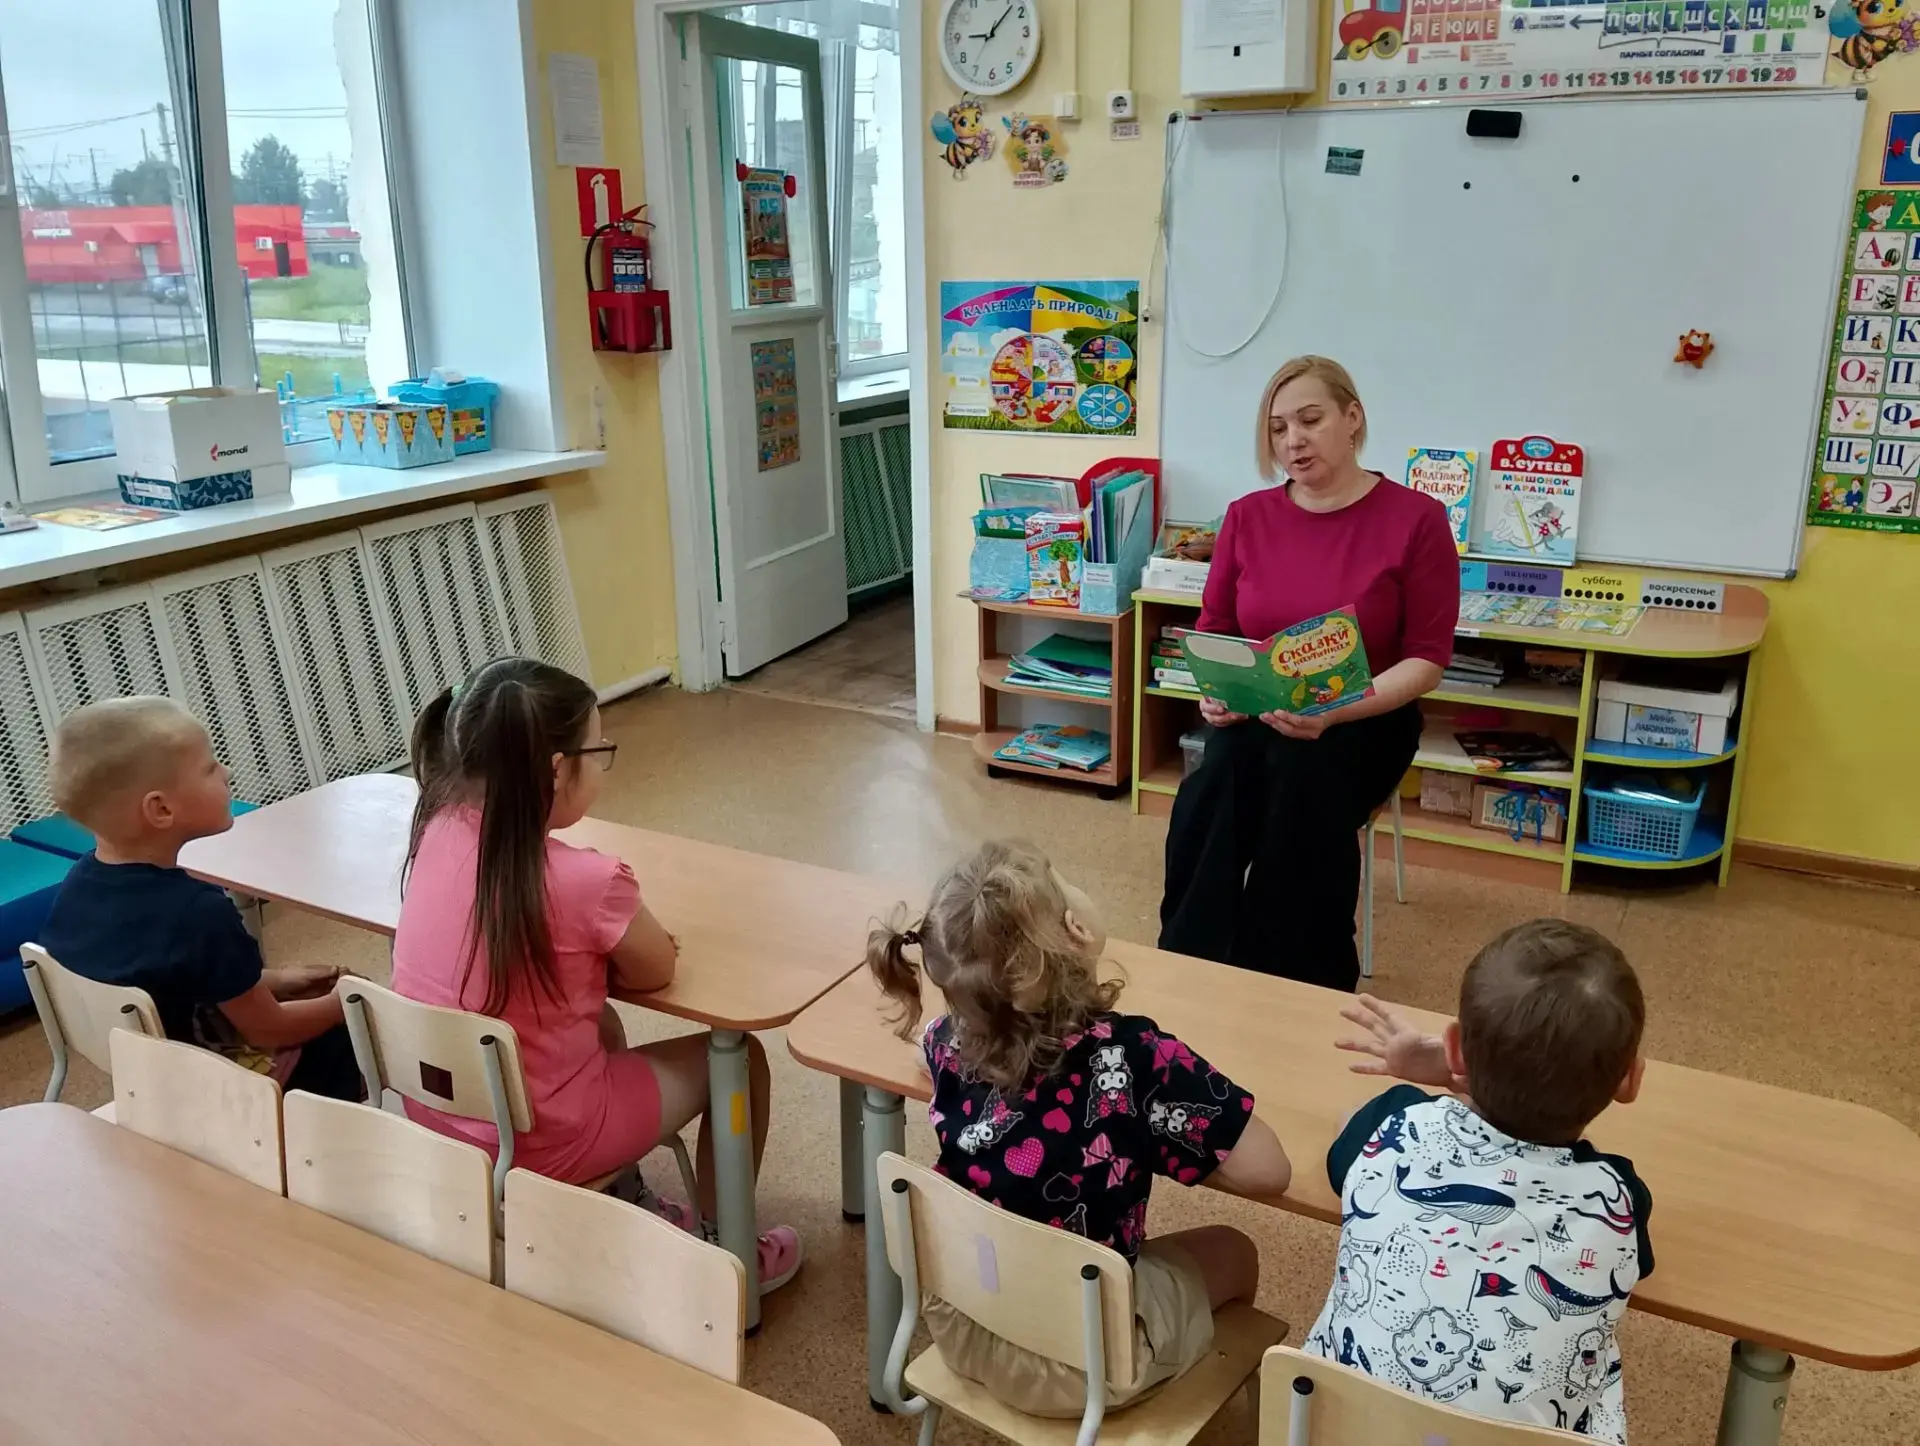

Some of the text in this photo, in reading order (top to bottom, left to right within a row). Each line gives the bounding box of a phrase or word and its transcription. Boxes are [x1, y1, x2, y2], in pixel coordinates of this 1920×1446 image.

[1017, 6, 1025, 19] 2
[1626, 11, 1642, 26] Ф
[1647, 10, 1660, 26] К
[1668, 10, 1679, 25] Т
[1684, 9, 1703, 24] Ш
[1707, 8, 1720, 24] С
[1727, 7, 1742, 23] Х
[1749, 7, 1763, 26] Ц
[1814, 5, 1826, 19] Ъ
[1022, 25, 1030, 38] 3
[1411, 22, 1423, 37] Я
[1447, 20, 1462, 34] Ю
[1465, 20, 1480, 34] И
[1486, 19, 1496, 34] Е
[953, 32, 961, 45] 9
[960, 52, 967, 63] 8
[1655, 49, 1706, 57] СОГЛАСНЫЕ
[972, 65, 979, 77] 7
[989, 67, 996, 80] 6
[1005, 62, 1013, 74] 5
[1337, 67, 1797, 96] 0 1 2 3 4 5 6 7 8 9 10 11 12 13 14 15 16 17 18 19 20
[1896, 202, 1920, 225] А
[1860, 237, 1883, 260] А
[1854, 278, 1875, 302] Е
[962, 299, 1119, 321] КАЛЕНДАРЬ ПРИРОДЫ
[1845, 315, 1920, 342] Й К
[1840, 359, 1916, 384] О П
[1836, 399, 1912, 425] У Ф
[217, 444, 248, 458] mondi
[1826, 440, 1905, 470] Ш Щ
[1500, 458, 1572, 473] В. СУТЕЕВ
[1502, 474, 1570, 486] МЫШОНОК
[1505, 484, 1575, 496] КАРАНДАШ
[1871, 482, 1893, 505] Э
[1582, 575, 1623, 587] суббота
[1648, 583, 1717, 597] воскресенье
[1634, 722, 1690, 736] ЛАБОРАТОРИЯ
[1433, 1381, 1469, 1400] Pirate Port
